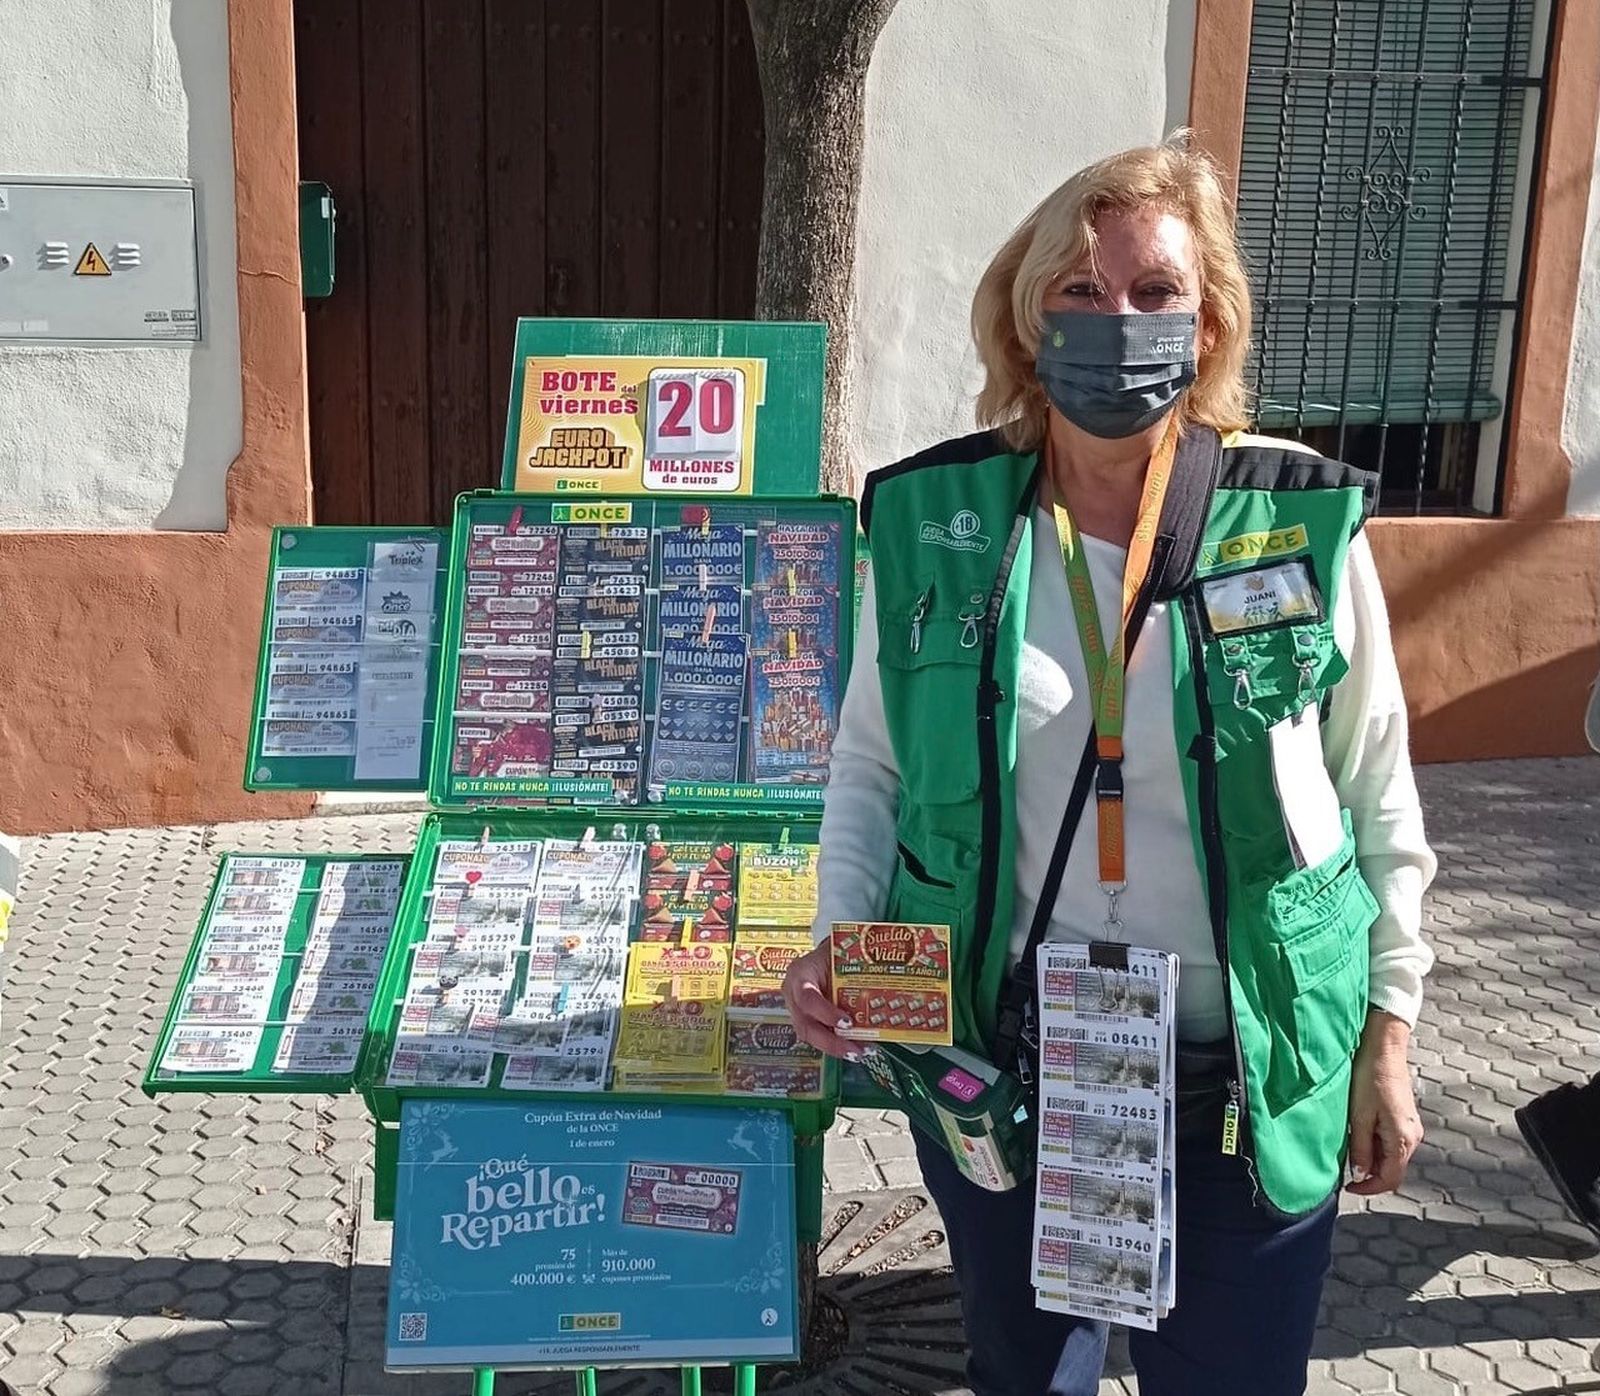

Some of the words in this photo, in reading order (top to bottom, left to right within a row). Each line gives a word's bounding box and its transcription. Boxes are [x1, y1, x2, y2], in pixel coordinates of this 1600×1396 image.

[1156, 343, 1184, 353] ONCE
[542, 371, 616, 393] BOTE
[621, 385, 637, 393] del
[539, 395, 638, 416] viernes
[657, 377, 736, 438] 20
[551, 428, 610, 449] EURO
[529, 446, 628, 469] JACKPOT
[650, 460, 735, 474] MILLONES
[569, 481, 599, 489] ONCE
[662, 474, 679, 484] de
[682, 475, 718, 485] euros
[575, 508, 627, 520] ONCE
[769, 532, 829, 544] NAVIDAD
[1227, 532, 1299, 556] ONCE
[663, 542, 742, 559] MILLONARIO
[663, 564, 743, 576] 1.000000€
[763, 596, 824, 609] NAVIDAD
[1244, 591, 1277, 604] JUANI
[603, 602, 640, 616] FRIDAY
[661, 601, 739, 617] MILLONRIO
[584, 658, 615, 671] BLACK
[664, 650, 744, 668] MILLONARIO
[600, 664, 638, 677] FRIDAY
[763, 660, 824, 673] NAVIDAD
[663, 672, 743, 686] 1.000.000€
[584, 723, 617, 737] BLACK
[601, 726, 640, 742] FRIDAY
[602, 761, 636, 770] 05390
[454, 782, 468, 791] NO
[470, 782, 480, 791] TE
[483, 782, 516, 792] RINDAS
[519, 782, 550, 792] NUNCA
[668, 786, 681, 796] NO
[684, 787, 694, 796] TE
[697, 787, 730, 797] RINDAS
[733, 787, 765, 798] NUNCA
[443, 853, 490, 865] CUPONAZO
[547, 852, 593, 863] CUPONAZO
[753, 854, 799, 867] BUZÓN
[866, 927, 912, 945] Sueldo
[761, 948, 798, 960] Sueldo
[869, 945, 908, 962] Vida
[1111, 1032, 1157, 1049] 08411
[524, 1112, 563, 1126] Cupón
[565, 1111, 597, 1122] Extra
[598, 1110, 614, 1121] de
[615, 1109, 663, 1120] Navidad
[1111, 1104, 1157, 1121] 72483
[566, 1125, 578, 1134] de
[579, 1124, 589, 1134] la
[589, 1123, 620, 1133] ONCE
[575, 1140, 587, 1148] de
[588, 1139, 616, 1148] enero
[1224, 1121, 1236, 1153] ONCE
[478, 1153, 530, 1182] ¡Qué
[701, 1173, 736, 1186] 00000
[465, 1166, 581, 1215] bello
[581, 1184, 596, 1196] es
[440, 1192, 607, 1251] Repartir!
[1108, 1235, 1152, 1253] 13940
[560, 1248, 576, 1261] 75
[535, 1262, 565, 1272] premios
[566, 1261, 576, 1270] de
[602, 1258, 656, 1273] 910.000
[510, 1271, 564, 1286] 400.000
[566, 1274, 577, 1285] €
[576, 1315, 617, 1328] ONCE
[552, 1345, 573, 1354] JUEGA
